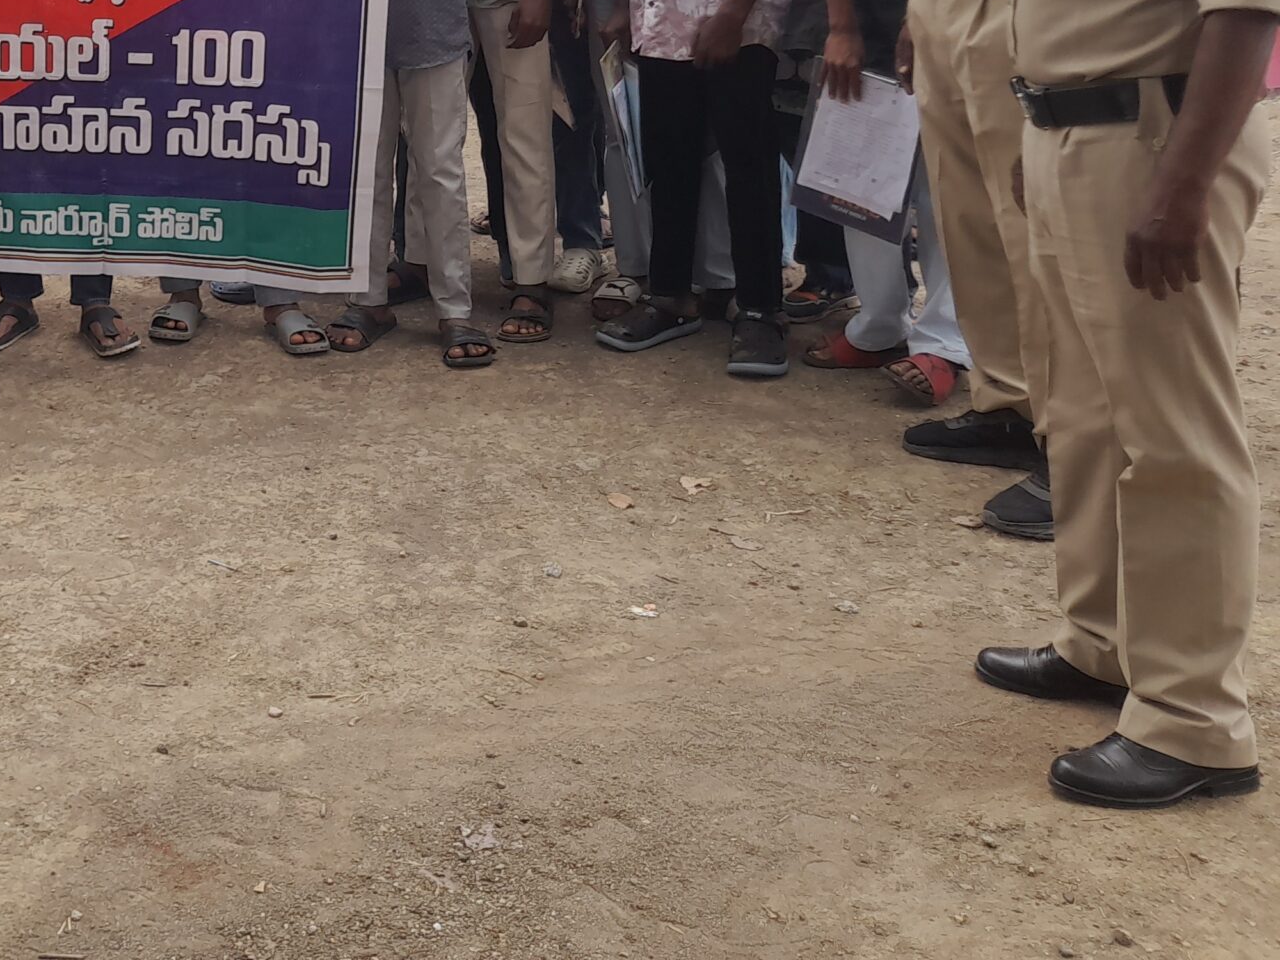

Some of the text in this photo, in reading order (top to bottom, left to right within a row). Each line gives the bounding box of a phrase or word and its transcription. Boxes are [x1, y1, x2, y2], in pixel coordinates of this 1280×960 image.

[171, 28, 267, 88] 100
[166, 98, 331, 188] సదస్సు
[20, 203, 131, 246] నార్నూర్
